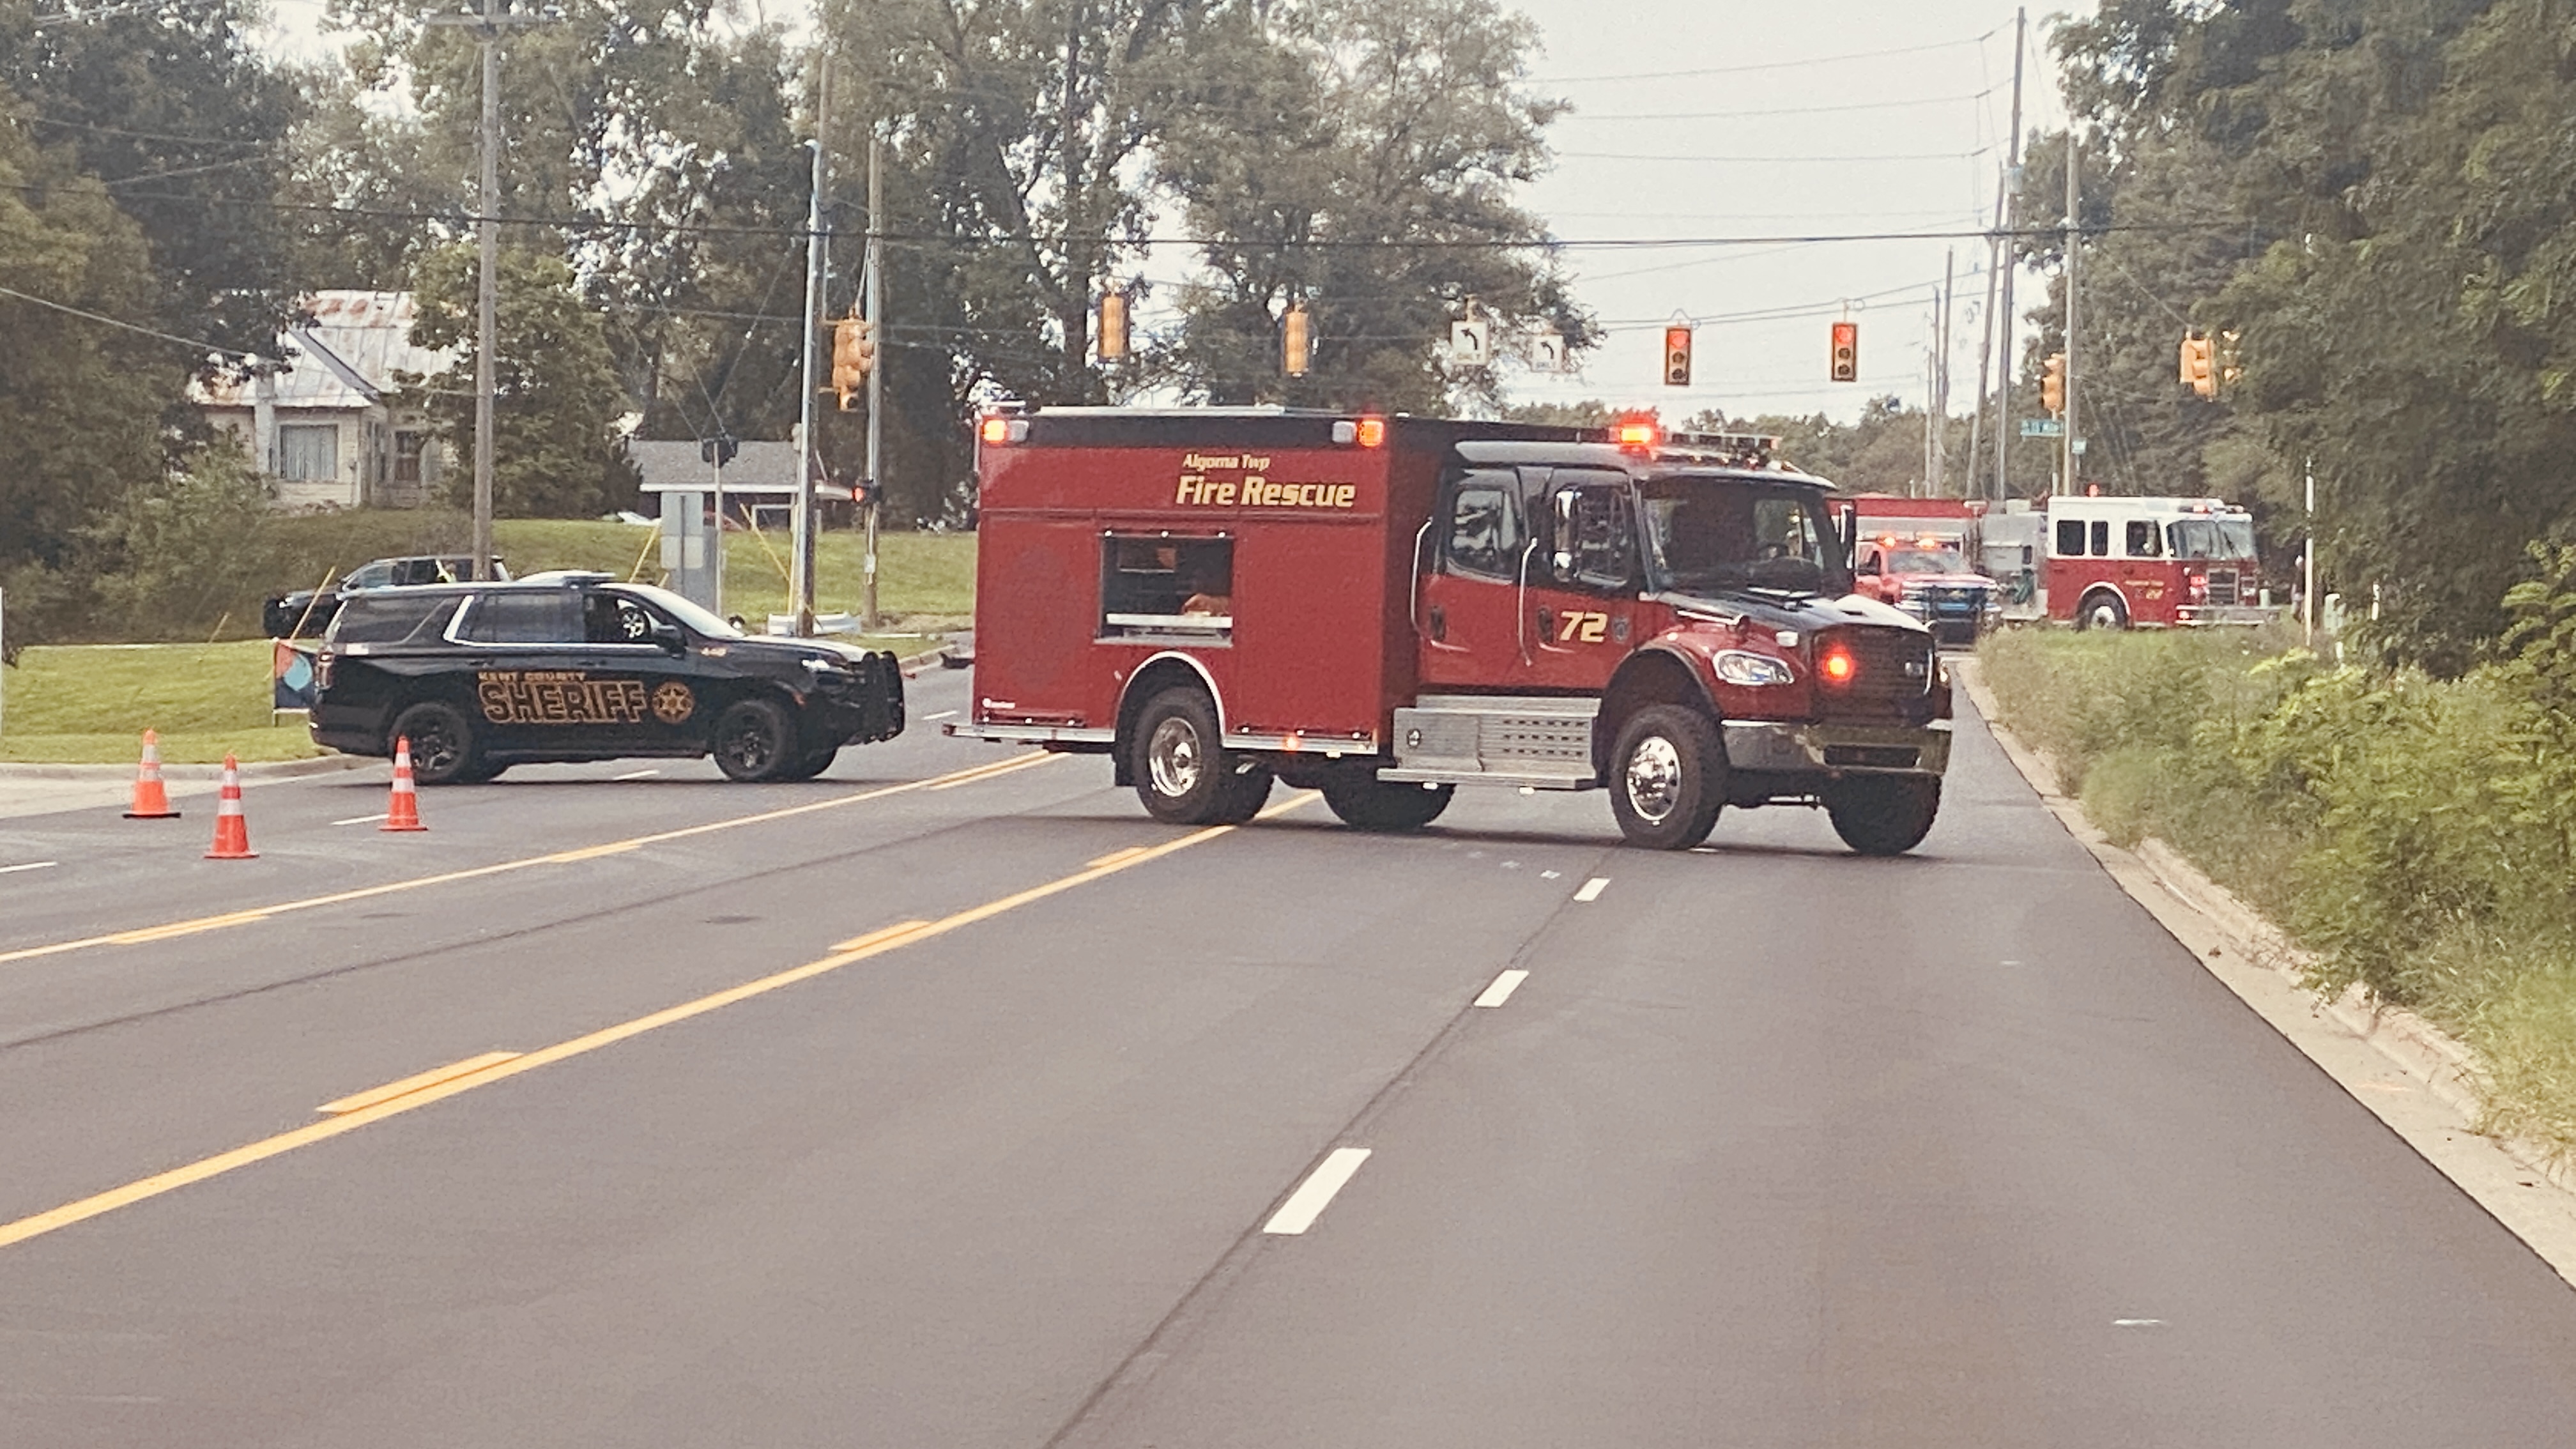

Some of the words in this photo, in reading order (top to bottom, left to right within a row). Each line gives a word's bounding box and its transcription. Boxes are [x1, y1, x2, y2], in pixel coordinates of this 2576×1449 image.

[1183, 454, 1239, 471] Algoma
[1241, 454, 1271, 471] Twp
[1176, 475, 1237, 505] Fire
[1240, 475, 1356, 507] Rescue
[1559, 611, 1608, 643] 72
[479, 671, 518, 681] KENT
[524, 671, 586, 682] COUNTY
[479, 680, 648, 724] SHERIFF
